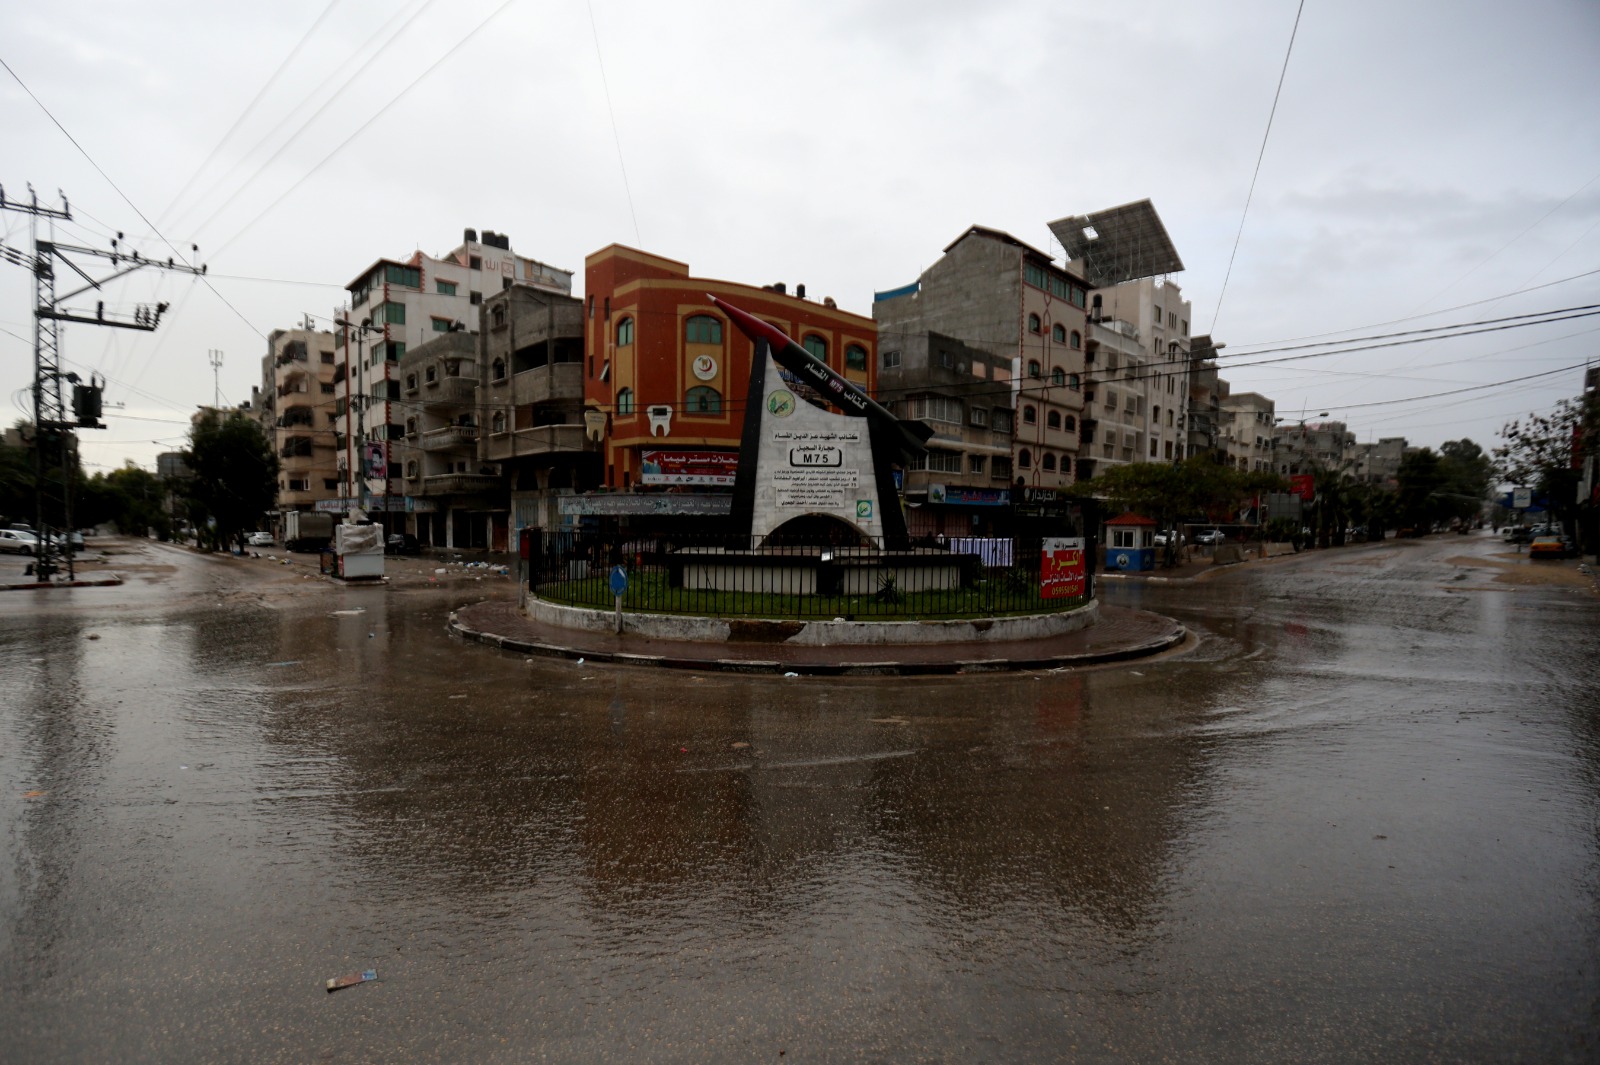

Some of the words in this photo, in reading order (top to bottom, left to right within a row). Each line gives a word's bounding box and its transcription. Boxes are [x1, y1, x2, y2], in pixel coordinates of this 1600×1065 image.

[804, 362, 829, 382] القسام
[829, 379, 844, 393] M75
[843, 390, 868, 410] كتائب
[774, 431, 793, 439] القسام
[793, 432, 808, 440] الدين
[819, 432, 837, 441] الشهيد
[838, 433, 858, 441] كتائب
[818, 445, 835, 453] حجارة
[1030, 488, 1057, 503] الخزندار
